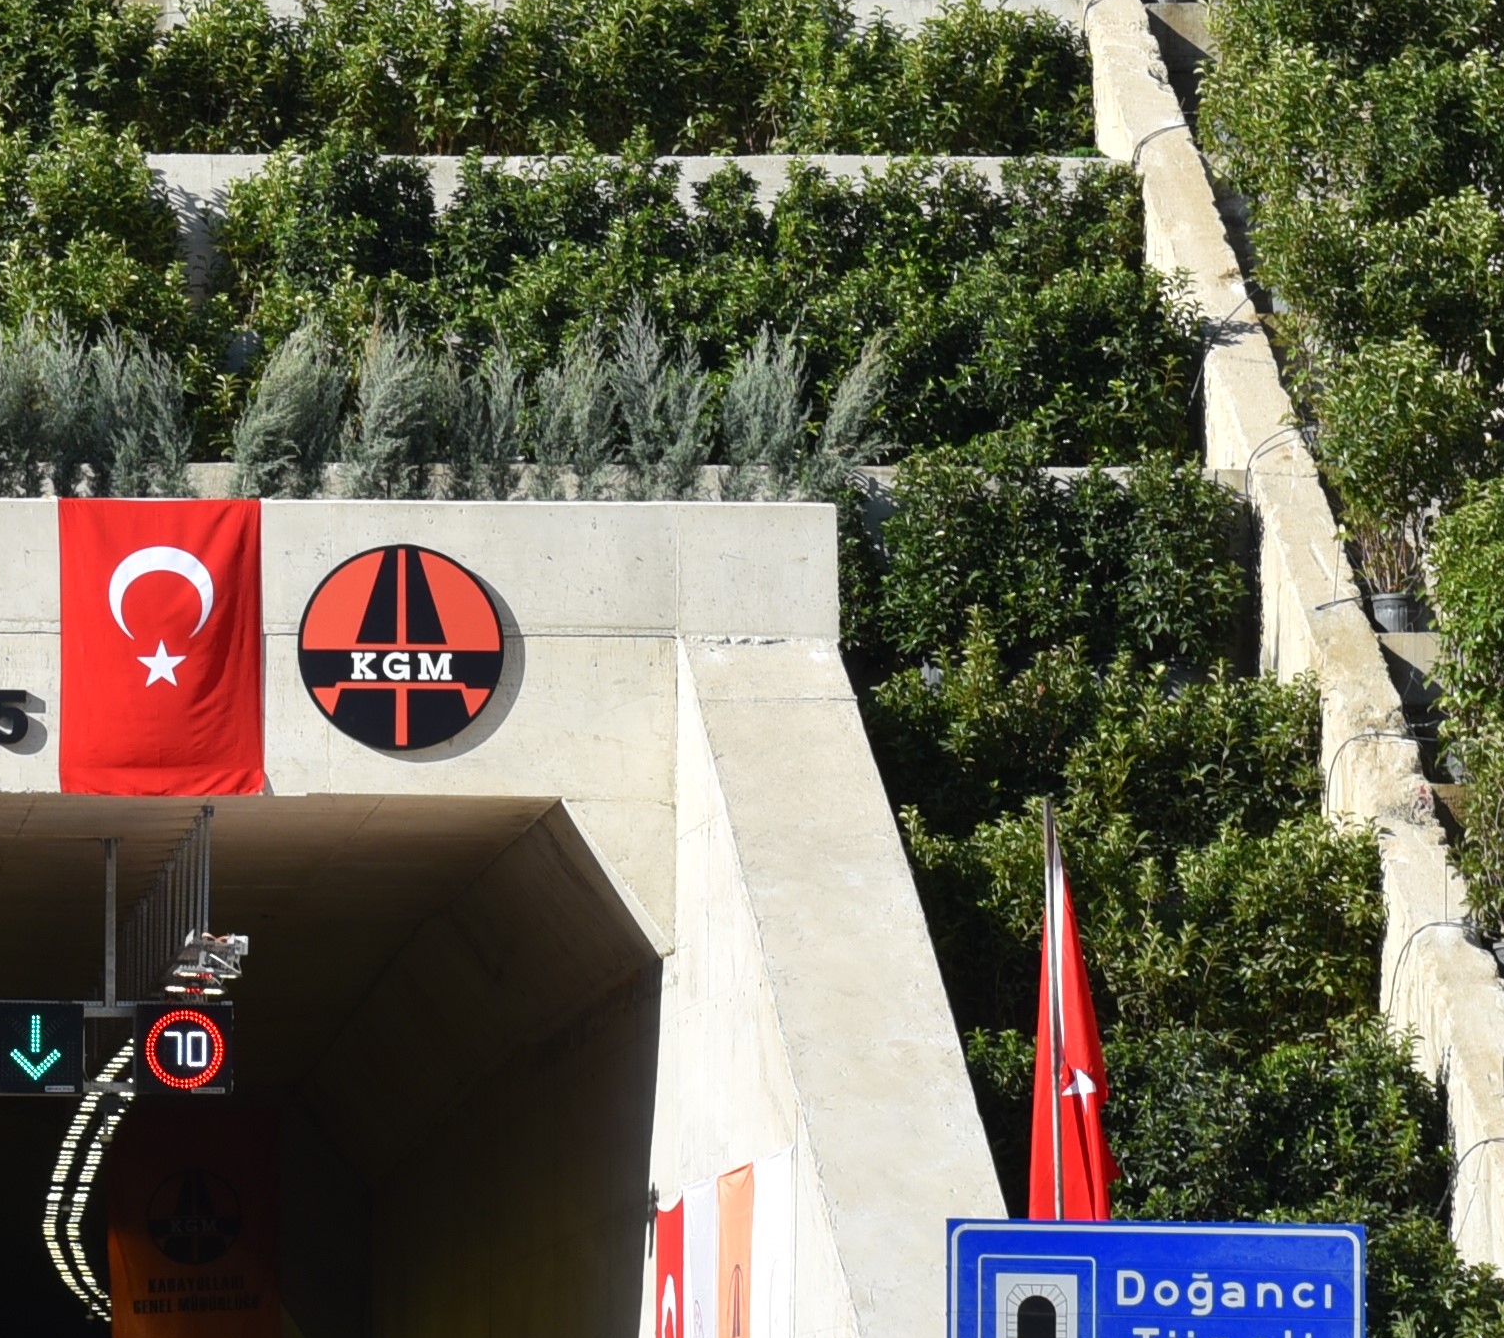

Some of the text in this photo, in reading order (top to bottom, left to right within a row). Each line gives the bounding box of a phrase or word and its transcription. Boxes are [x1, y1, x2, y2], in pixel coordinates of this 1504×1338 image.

[350, 651, 454, 682] KGM
[163, 1031, 207, 1067] 70
[170, 1219, 217, 1233] KGM
[133, 1299, 173, 1315] GENEL
[1116, 1270, 1332, 1316] Doğancı
